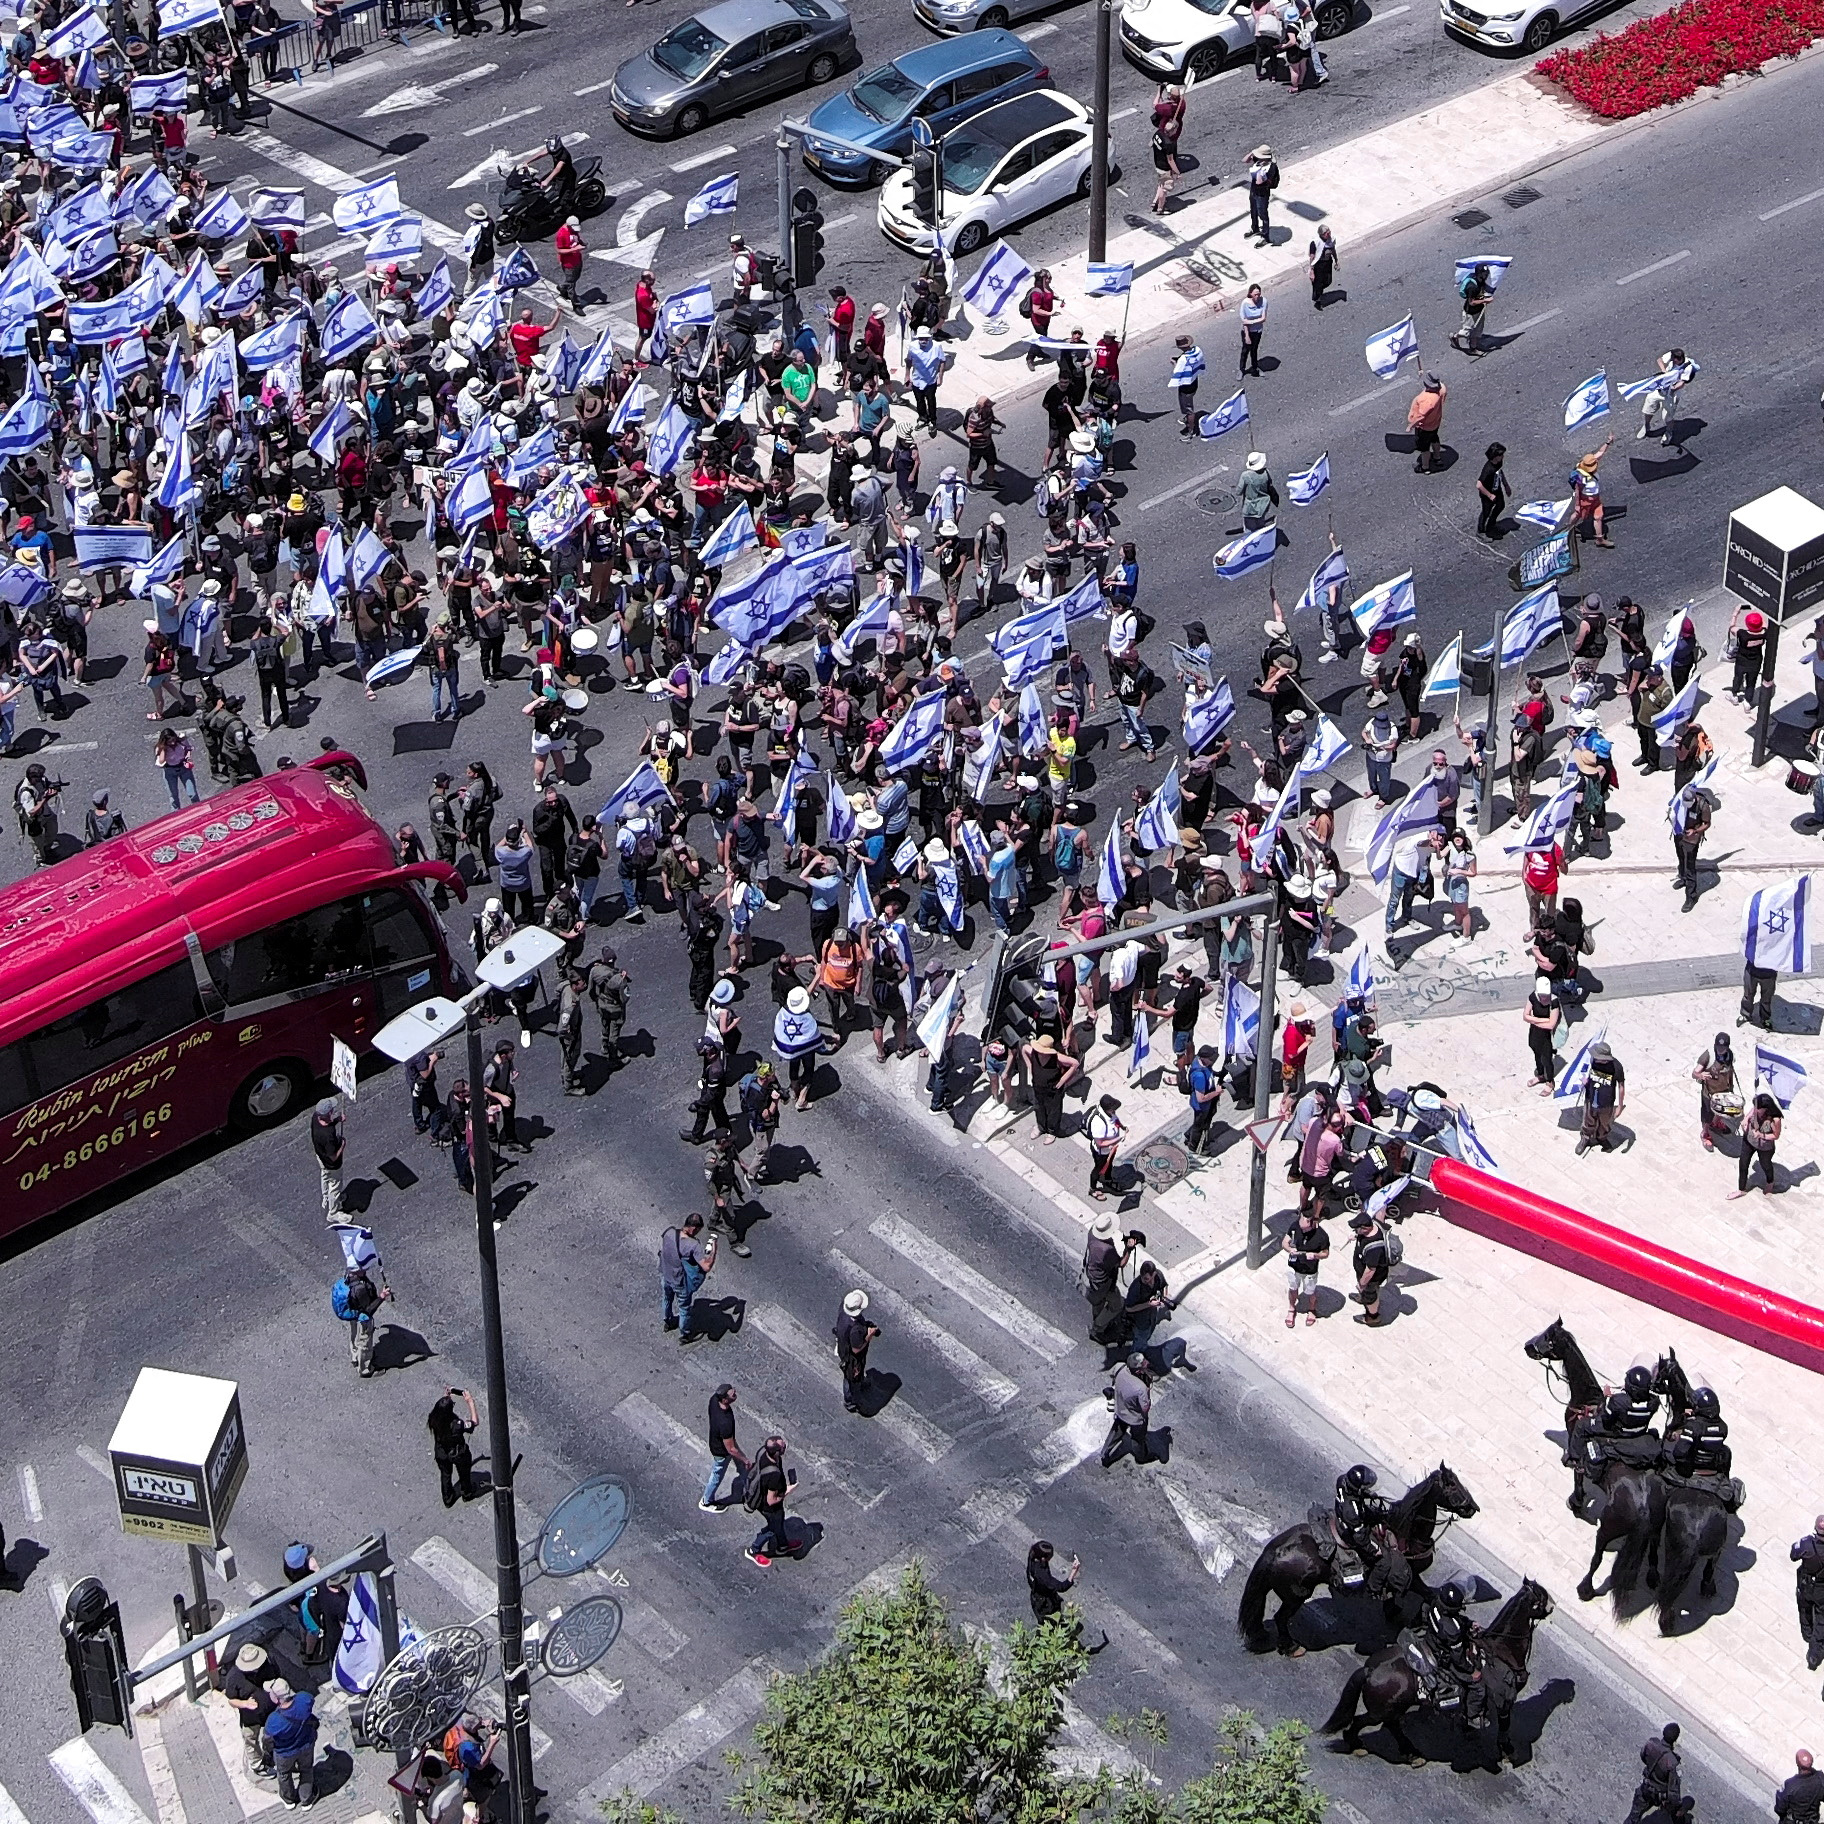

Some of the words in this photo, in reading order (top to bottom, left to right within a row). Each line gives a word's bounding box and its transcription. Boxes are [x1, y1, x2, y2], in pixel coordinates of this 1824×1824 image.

[12, 1088, 83, 1137] Rubin
[90, 1046, 168, 1098] tourism
[19, 1103, 172, 1191] 04-8666166
